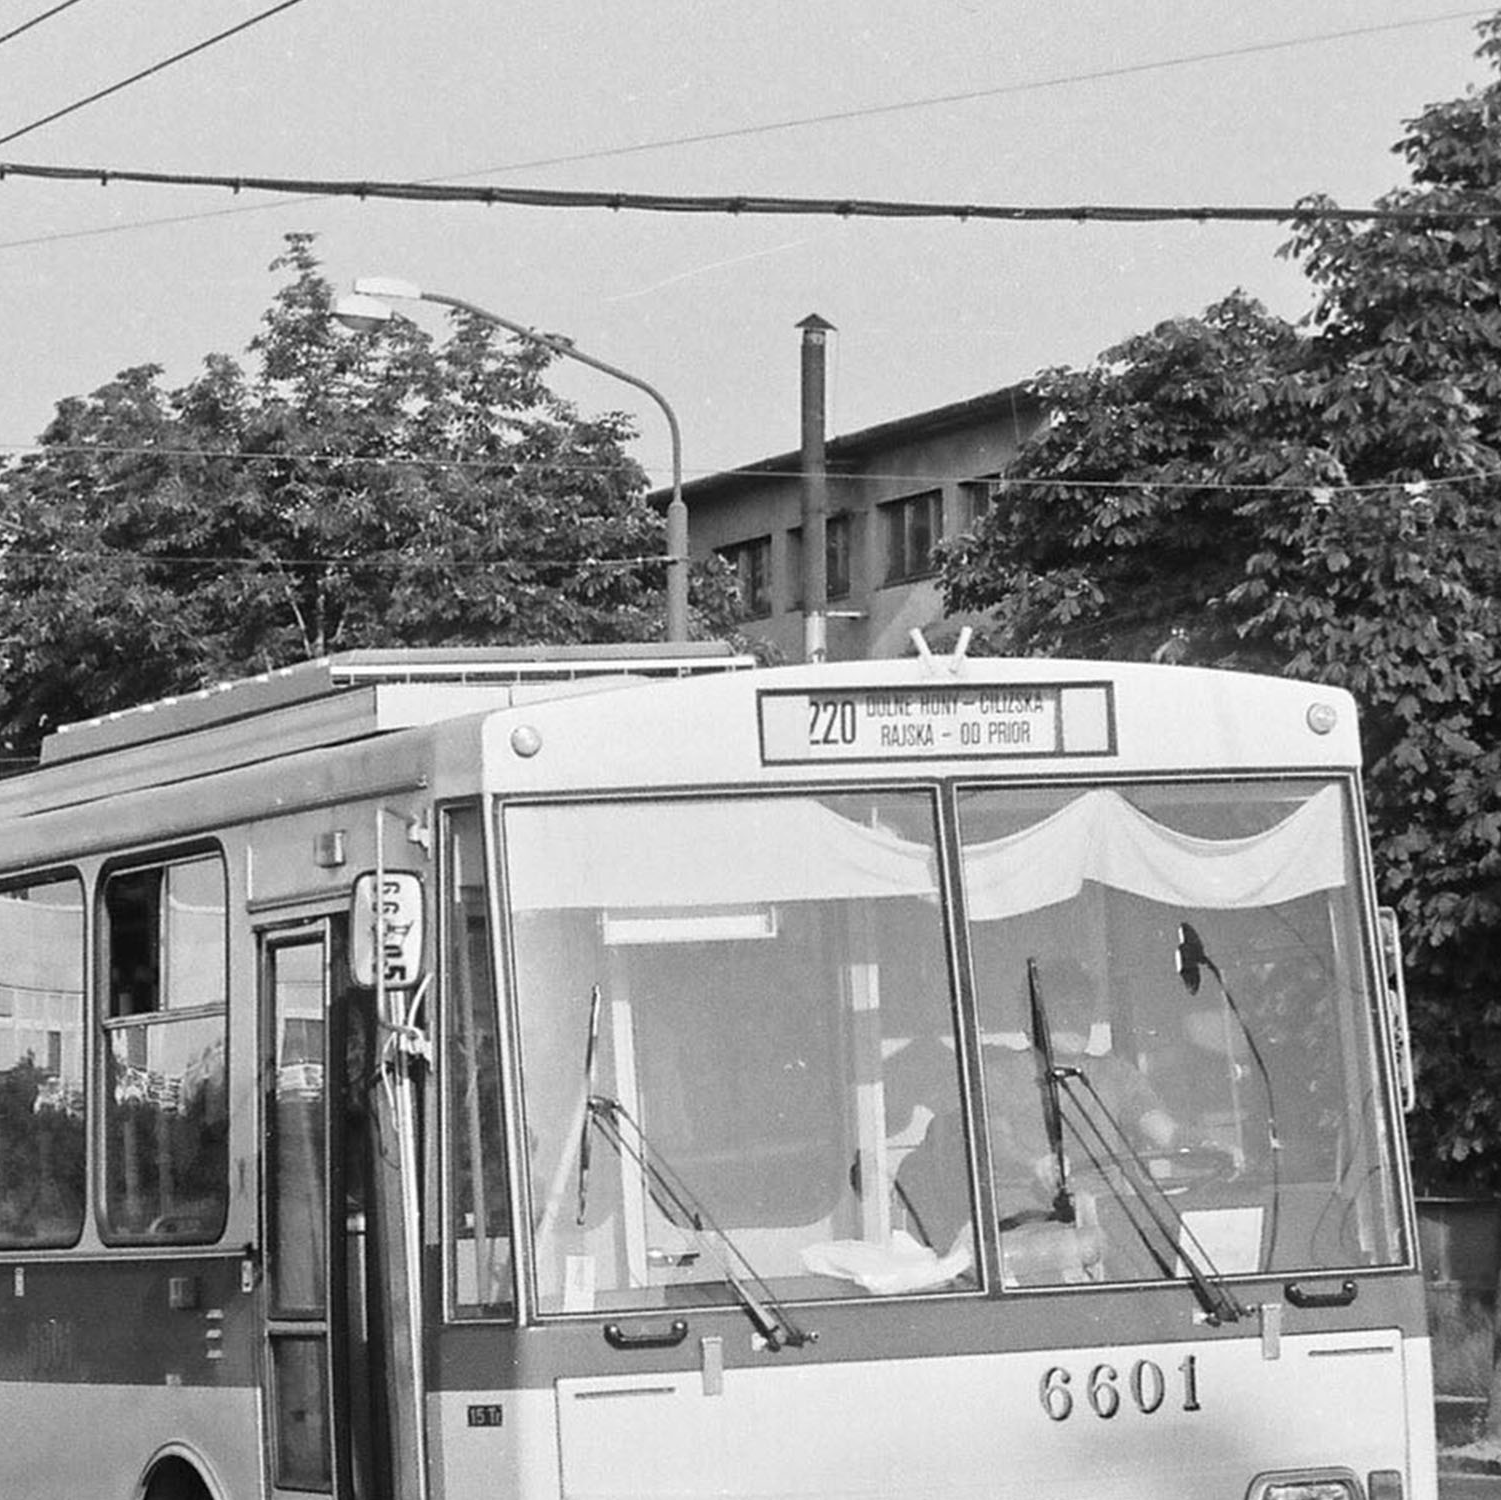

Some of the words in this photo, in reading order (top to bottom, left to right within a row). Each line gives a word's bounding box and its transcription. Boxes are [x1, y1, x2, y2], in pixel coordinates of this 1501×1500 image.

[809, 700, 857, 745] 220
[960, 721, 981, 745] OD
[988, 720, 1031, 744] PRIOR
[1040, 1354, 1202, 1421] 6601
